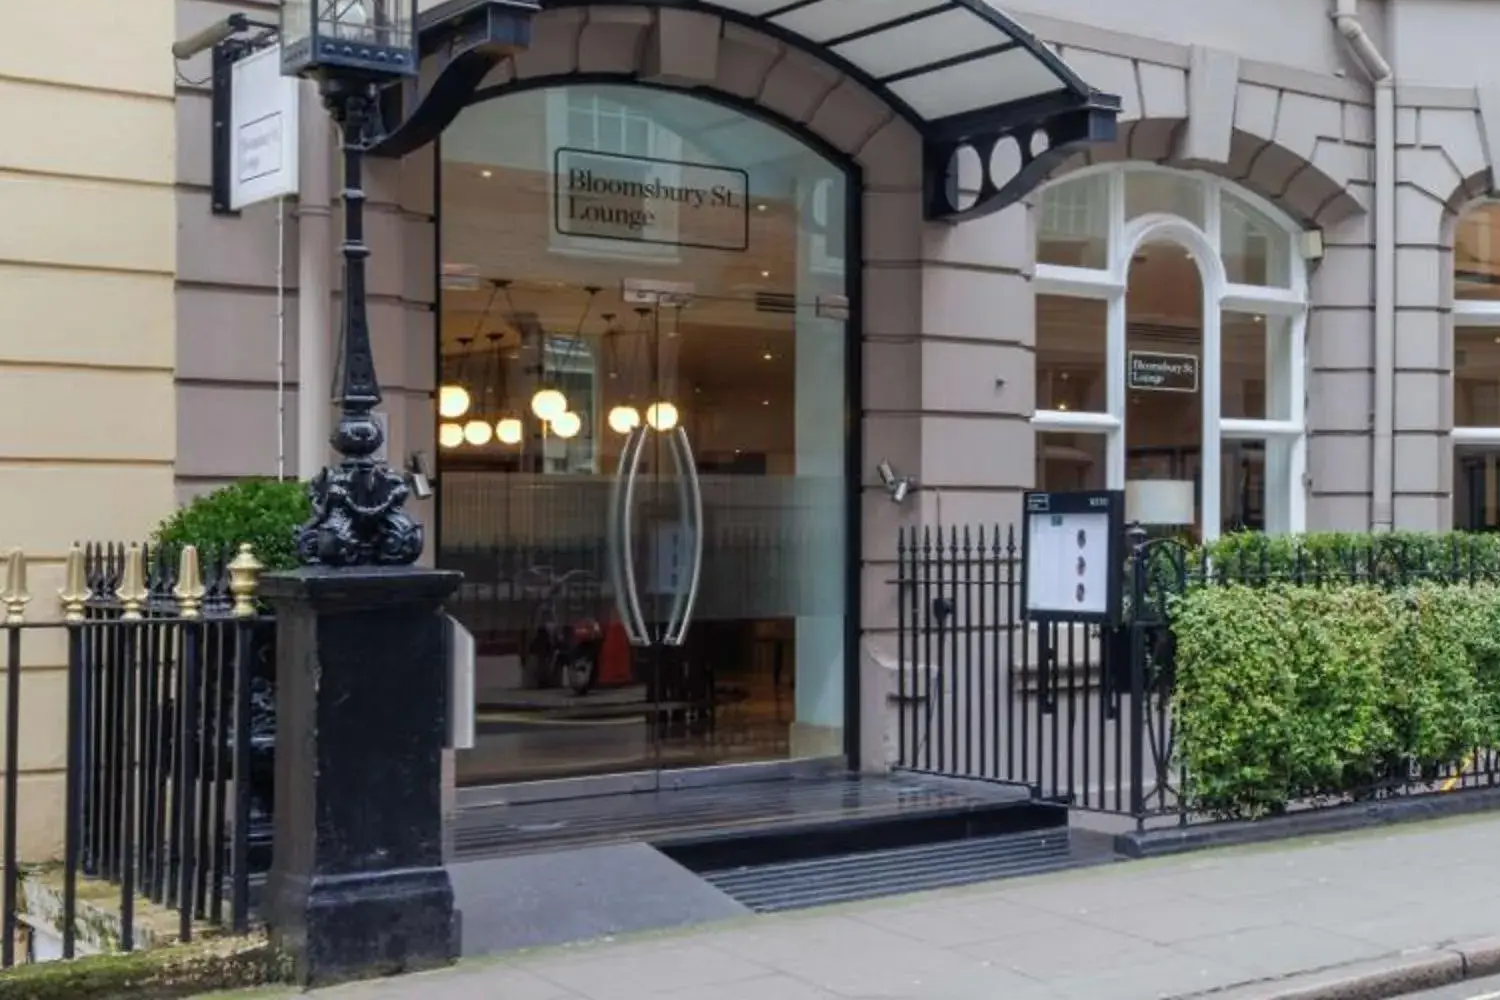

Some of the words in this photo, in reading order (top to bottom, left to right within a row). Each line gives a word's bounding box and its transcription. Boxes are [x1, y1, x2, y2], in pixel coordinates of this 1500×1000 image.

[568, 168, 706, 208] Bloomsbury
[711, 184, 739, 208] St.
[568, 195, 655, 230] Lounge
